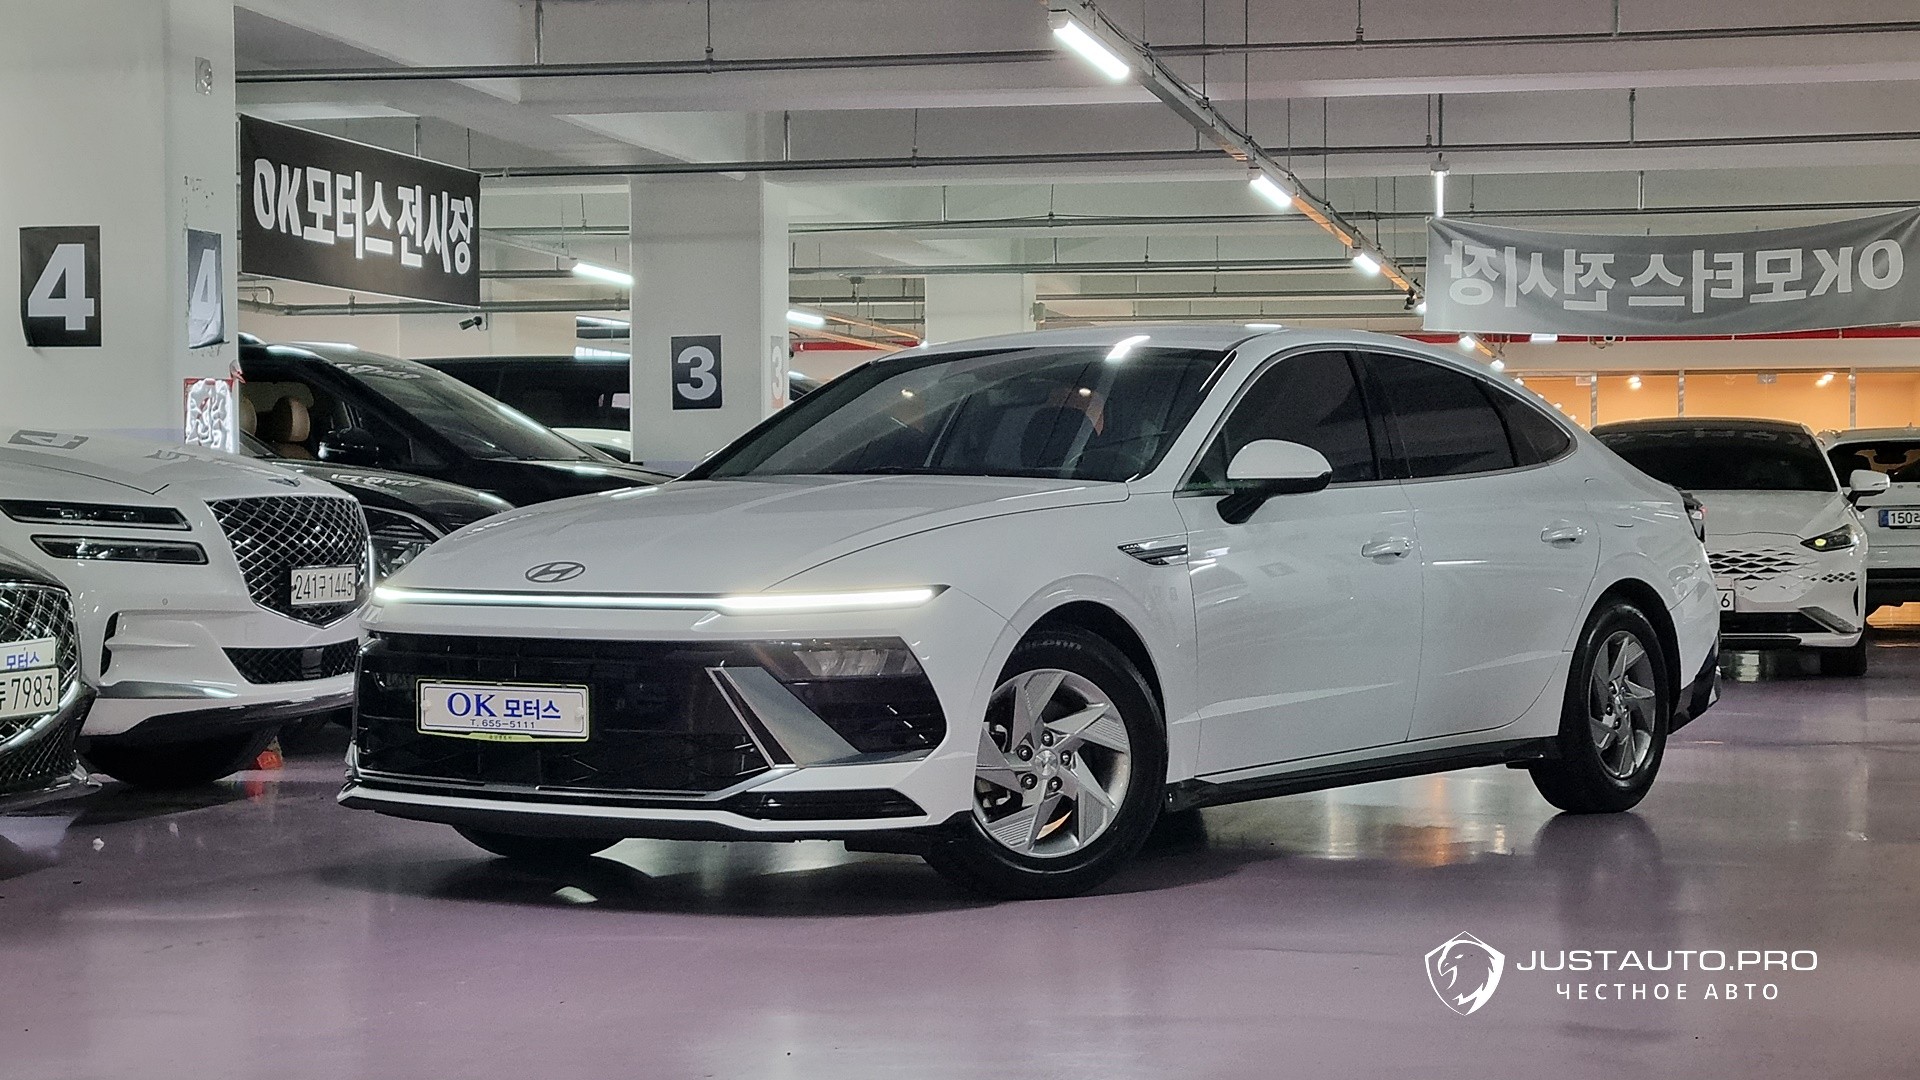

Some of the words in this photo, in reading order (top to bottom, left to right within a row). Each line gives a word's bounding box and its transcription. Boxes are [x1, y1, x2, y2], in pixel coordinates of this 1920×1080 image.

[27, 243, 95, 331] 4
[189, 248, 223, 340] 4
[676, 345, 717, 400] 3
[771, 345, 784, 400] 3
[296, 572, 353, 600] 241구1445
[447, 692, 498, 717] OK
[503, 699, 561, 721] 모터스
